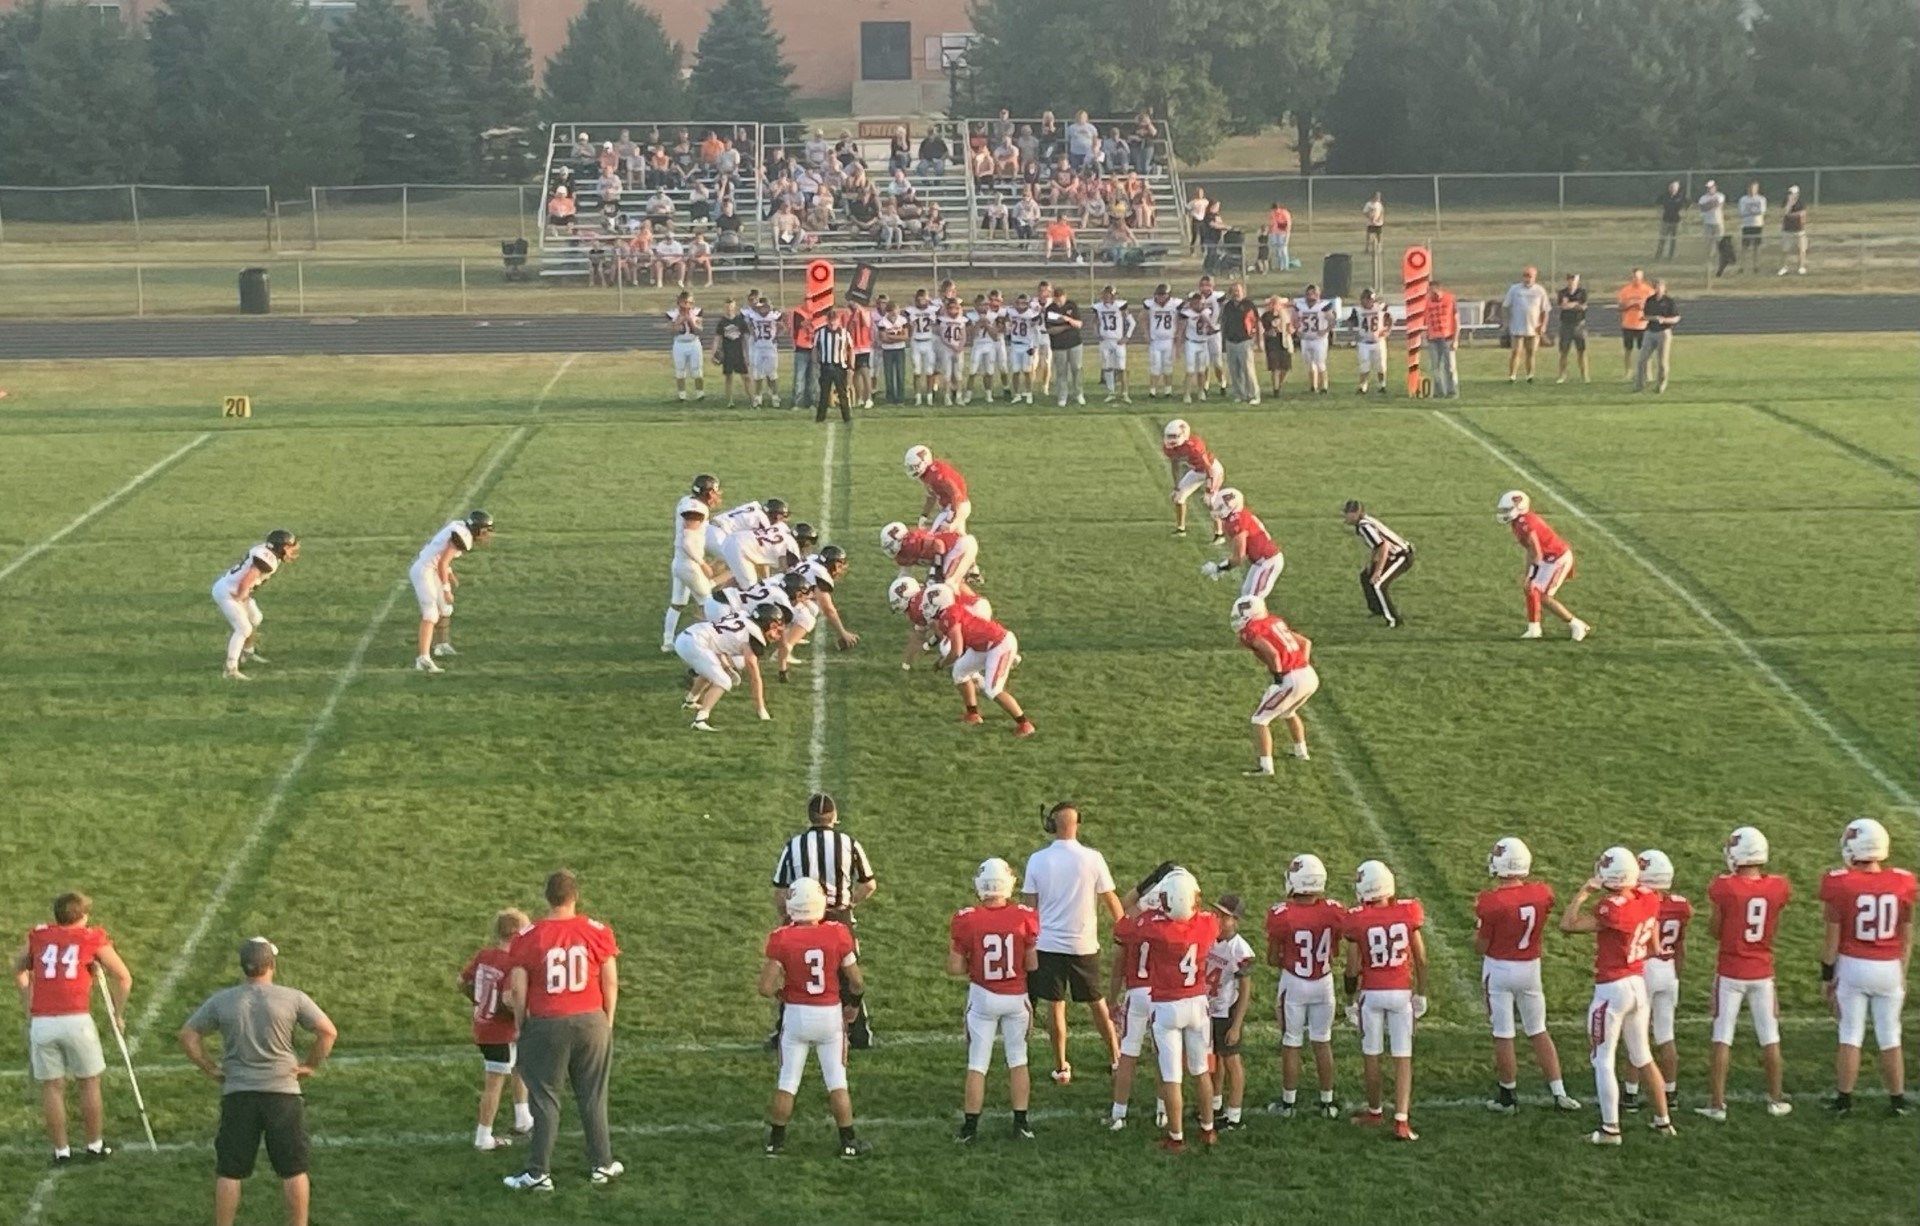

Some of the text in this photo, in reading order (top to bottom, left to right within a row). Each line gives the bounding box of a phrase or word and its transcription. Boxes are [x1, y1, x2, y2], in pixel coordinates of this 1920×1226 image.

[1102, 314, 1117, 331] 13
[1154, 314, 1172, 330] 78
[226, 397, 245, 418] 20
[1518, 906, 1536, 950] 7
[1745, 897, 1767, 943] 9
[1855, 893, 1899, 942] 20
[40, 942, 80, 980] 44
[983, 933, 1016, 981] 21
[1179, 942, 1199, 987] 4
[1294, 929, 1332, 978] 34
[1367, 922, 1409, 969] 82
[545, 944, 589, 995] 60
[804, 948, 826, 996] 3
